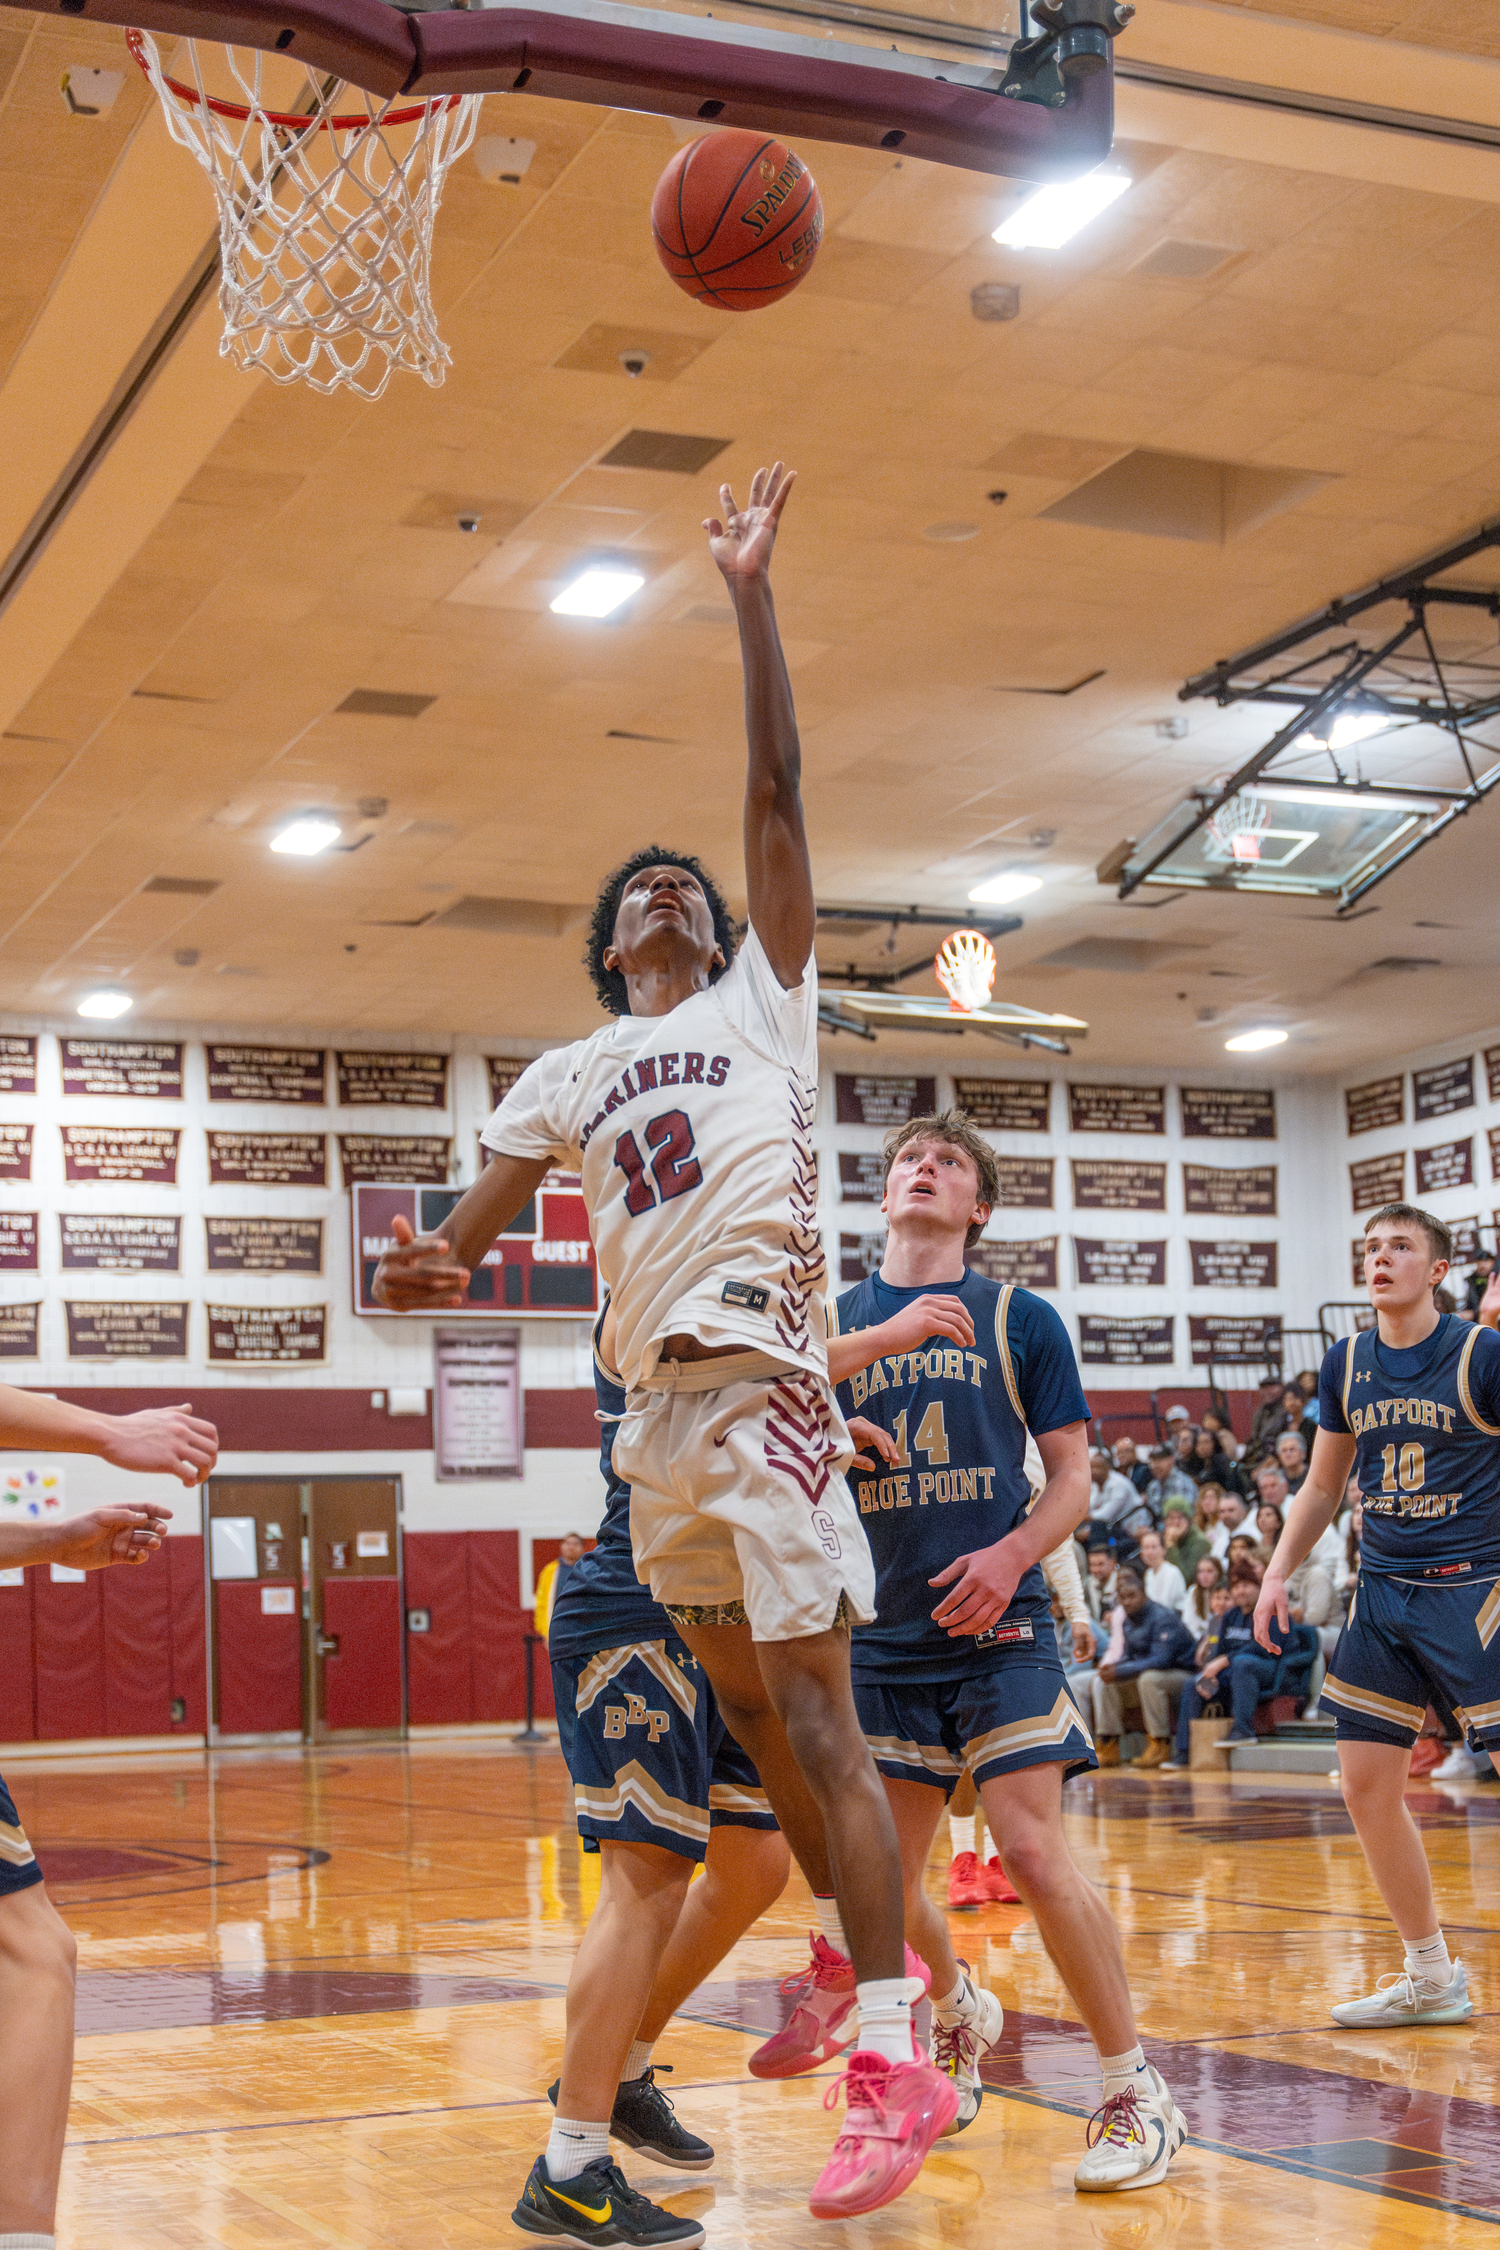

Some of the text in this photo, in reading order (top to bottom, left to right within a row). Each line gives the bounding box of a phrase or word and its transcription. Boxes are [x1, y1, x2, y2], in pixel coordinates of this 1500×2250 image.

[613, 1108, 703, 1218] 12
[532, 1240, 590, 1262] GUEST
[753, 1294, 763, 1305] M
[849, 1348, 987, 1410] BAYPORT
[889, 1401, 949, 1470] 14
[1351, 1398, 1456, 1439] BAYPORT
[858, 1466, 996, 1514] BLUE POINT
[1381, 1442, 1425, 1493] 10
[1397, 1493, 1462, 1518] POINT
[811, 1510, 842, 1560] S
